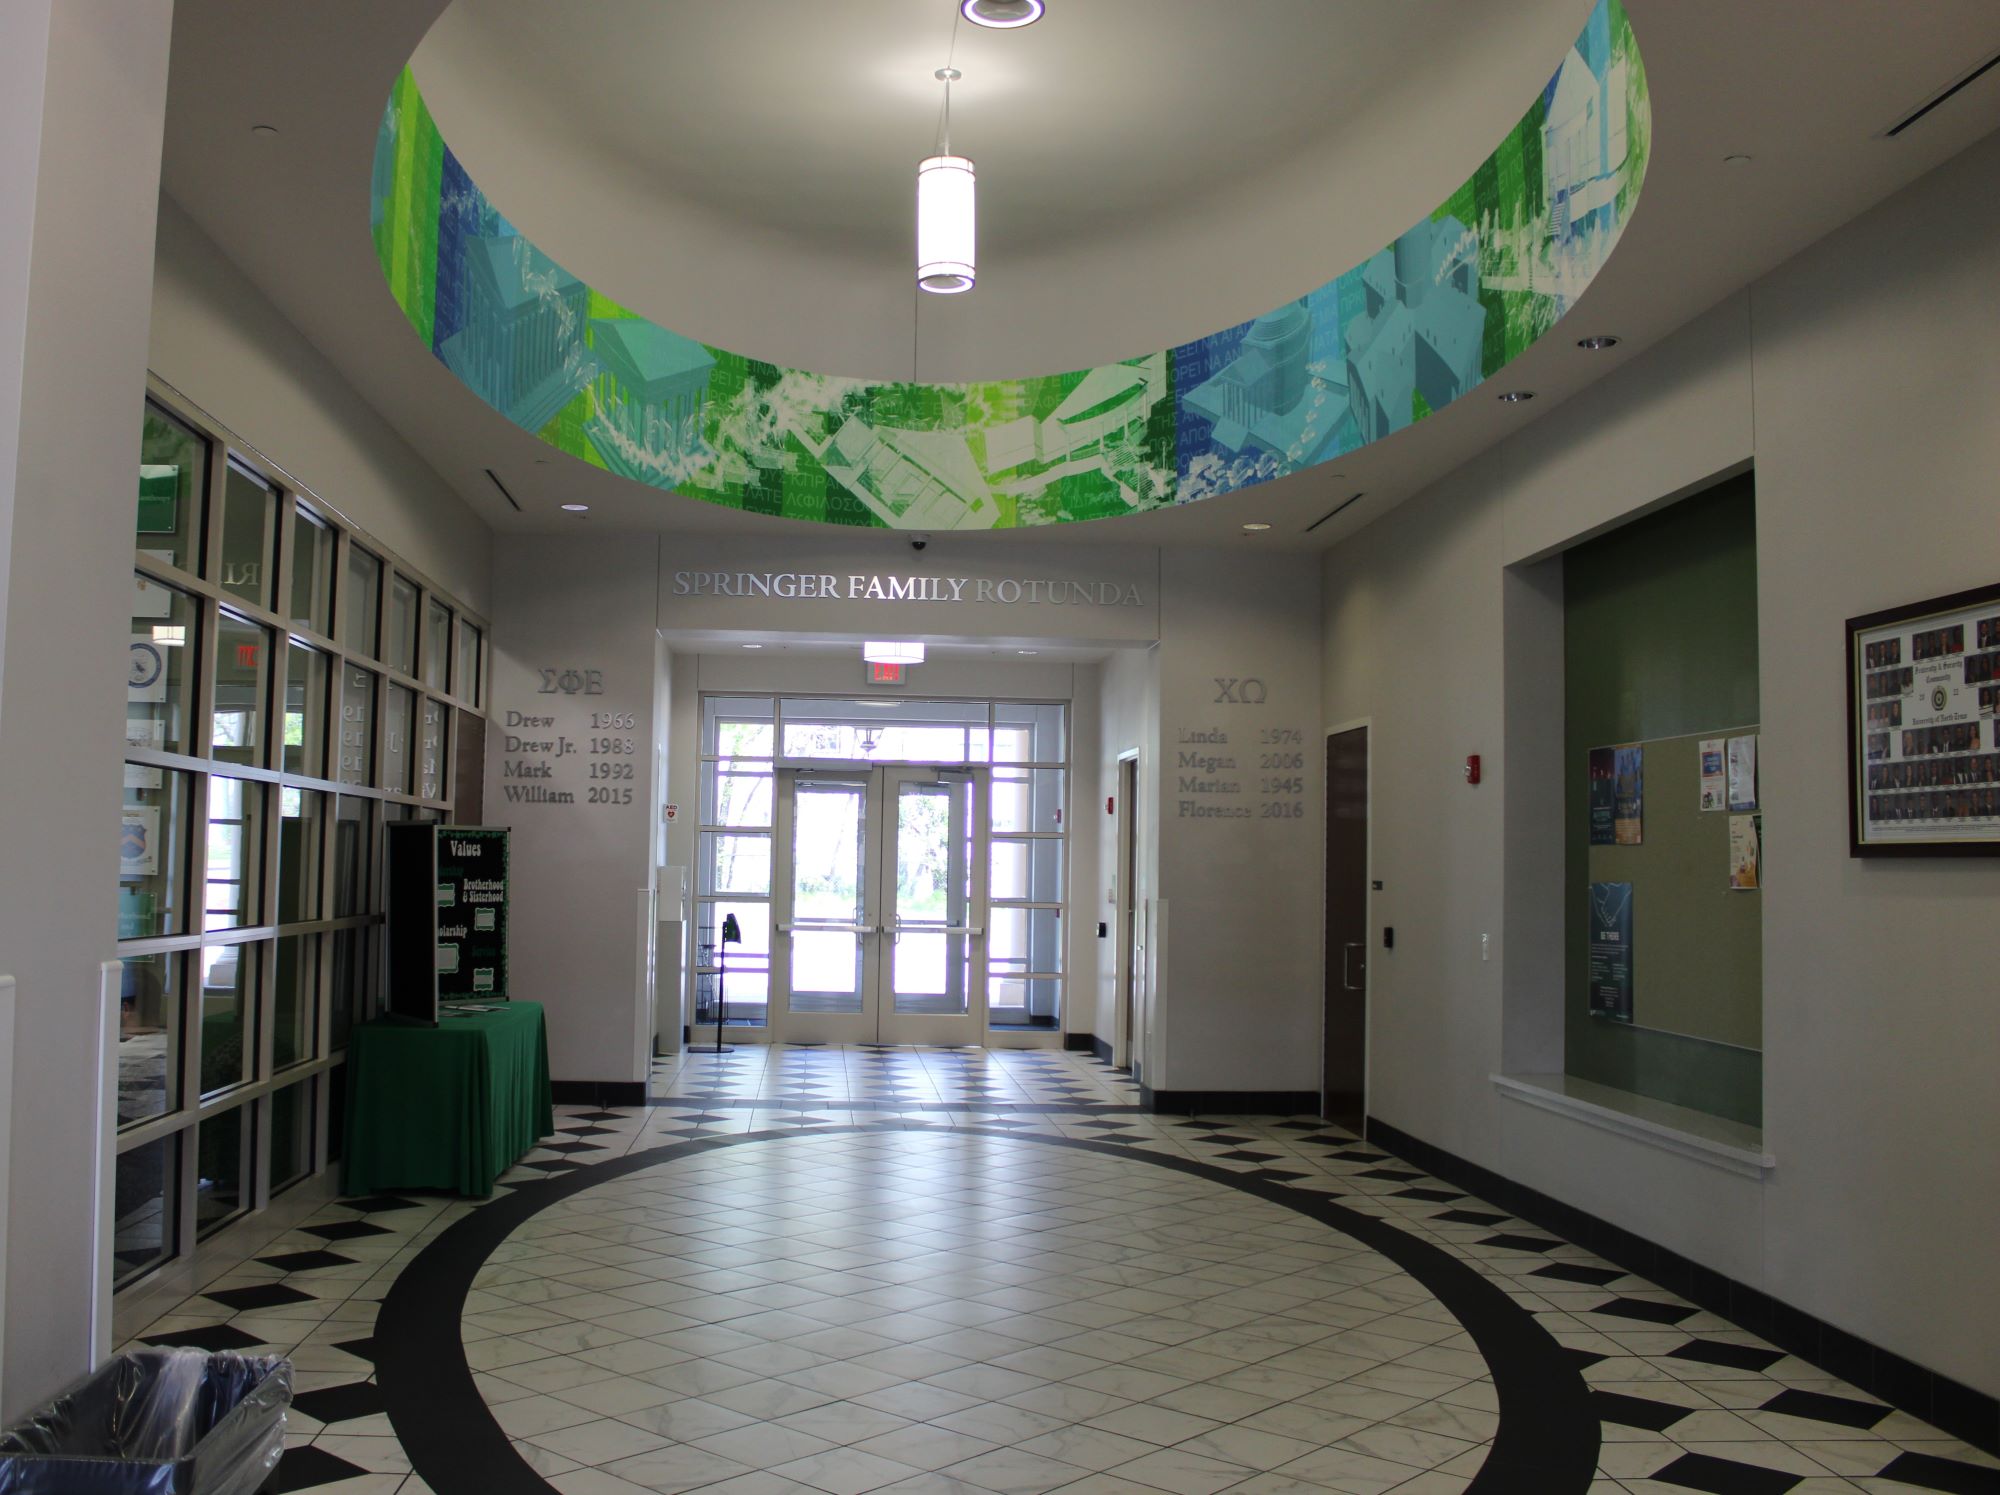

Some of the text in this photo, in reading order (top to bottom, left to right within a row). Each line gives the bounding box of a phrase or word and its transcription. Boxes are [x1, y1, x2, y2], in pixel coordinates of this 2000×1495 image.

[673, 571, 1145, 606] SPRINGER FAMILY ROTUNDA
[506, 710, 635, 730] Drew 1966
[1178, 727, 1228, 744] Linda
[504, 735, 634, 758] Drew Jr. 1988
[504, 760, 634, 780] Mark 1992
[1178, 751, 1237, 774] Megan
[1261, 777, 1304, 794] 1945
[503, 785, 633, 805] William 2015
[1179, 800, 1304, 818] Florence 2016
[450, 840, 482, 857] Values
[463, 878, 504, 891] Brotherhood
[462, 890, 504, 904] & Sisterhood
[438, 924, 468, 939] olarship
